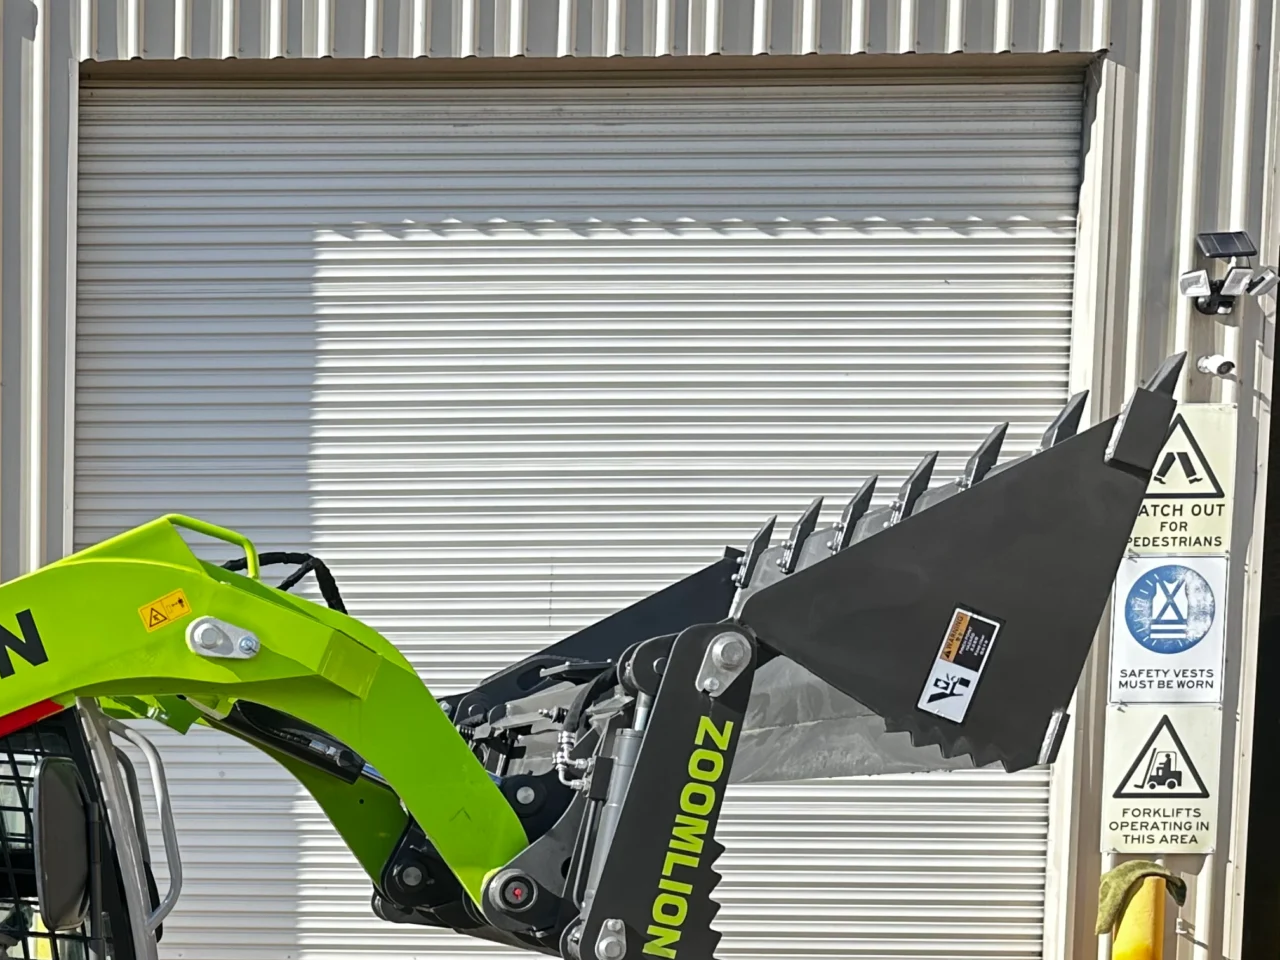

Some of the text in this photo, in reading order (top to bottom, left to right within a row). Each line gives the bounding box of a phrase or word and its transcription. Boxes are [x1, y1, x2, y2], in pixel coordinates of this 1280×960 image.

[1137, 503, 1225, 517] ATCH OUT
[1160, 521, 1188, 532] FOR
[948, 615, 964, 649] WARNING
[1120, 669, 1214, 678] SAFETY VESTS
[1118, 680, 1214, 689] MUST BE WORN
[1122, 808, 1201, 818] FORKLIFTS
[1109, 821, 1209, 831] OPERATING IN
[642, 715, 734, 960] ZOOMLION
[1122, 834, 1198, 844] THIS AREA
